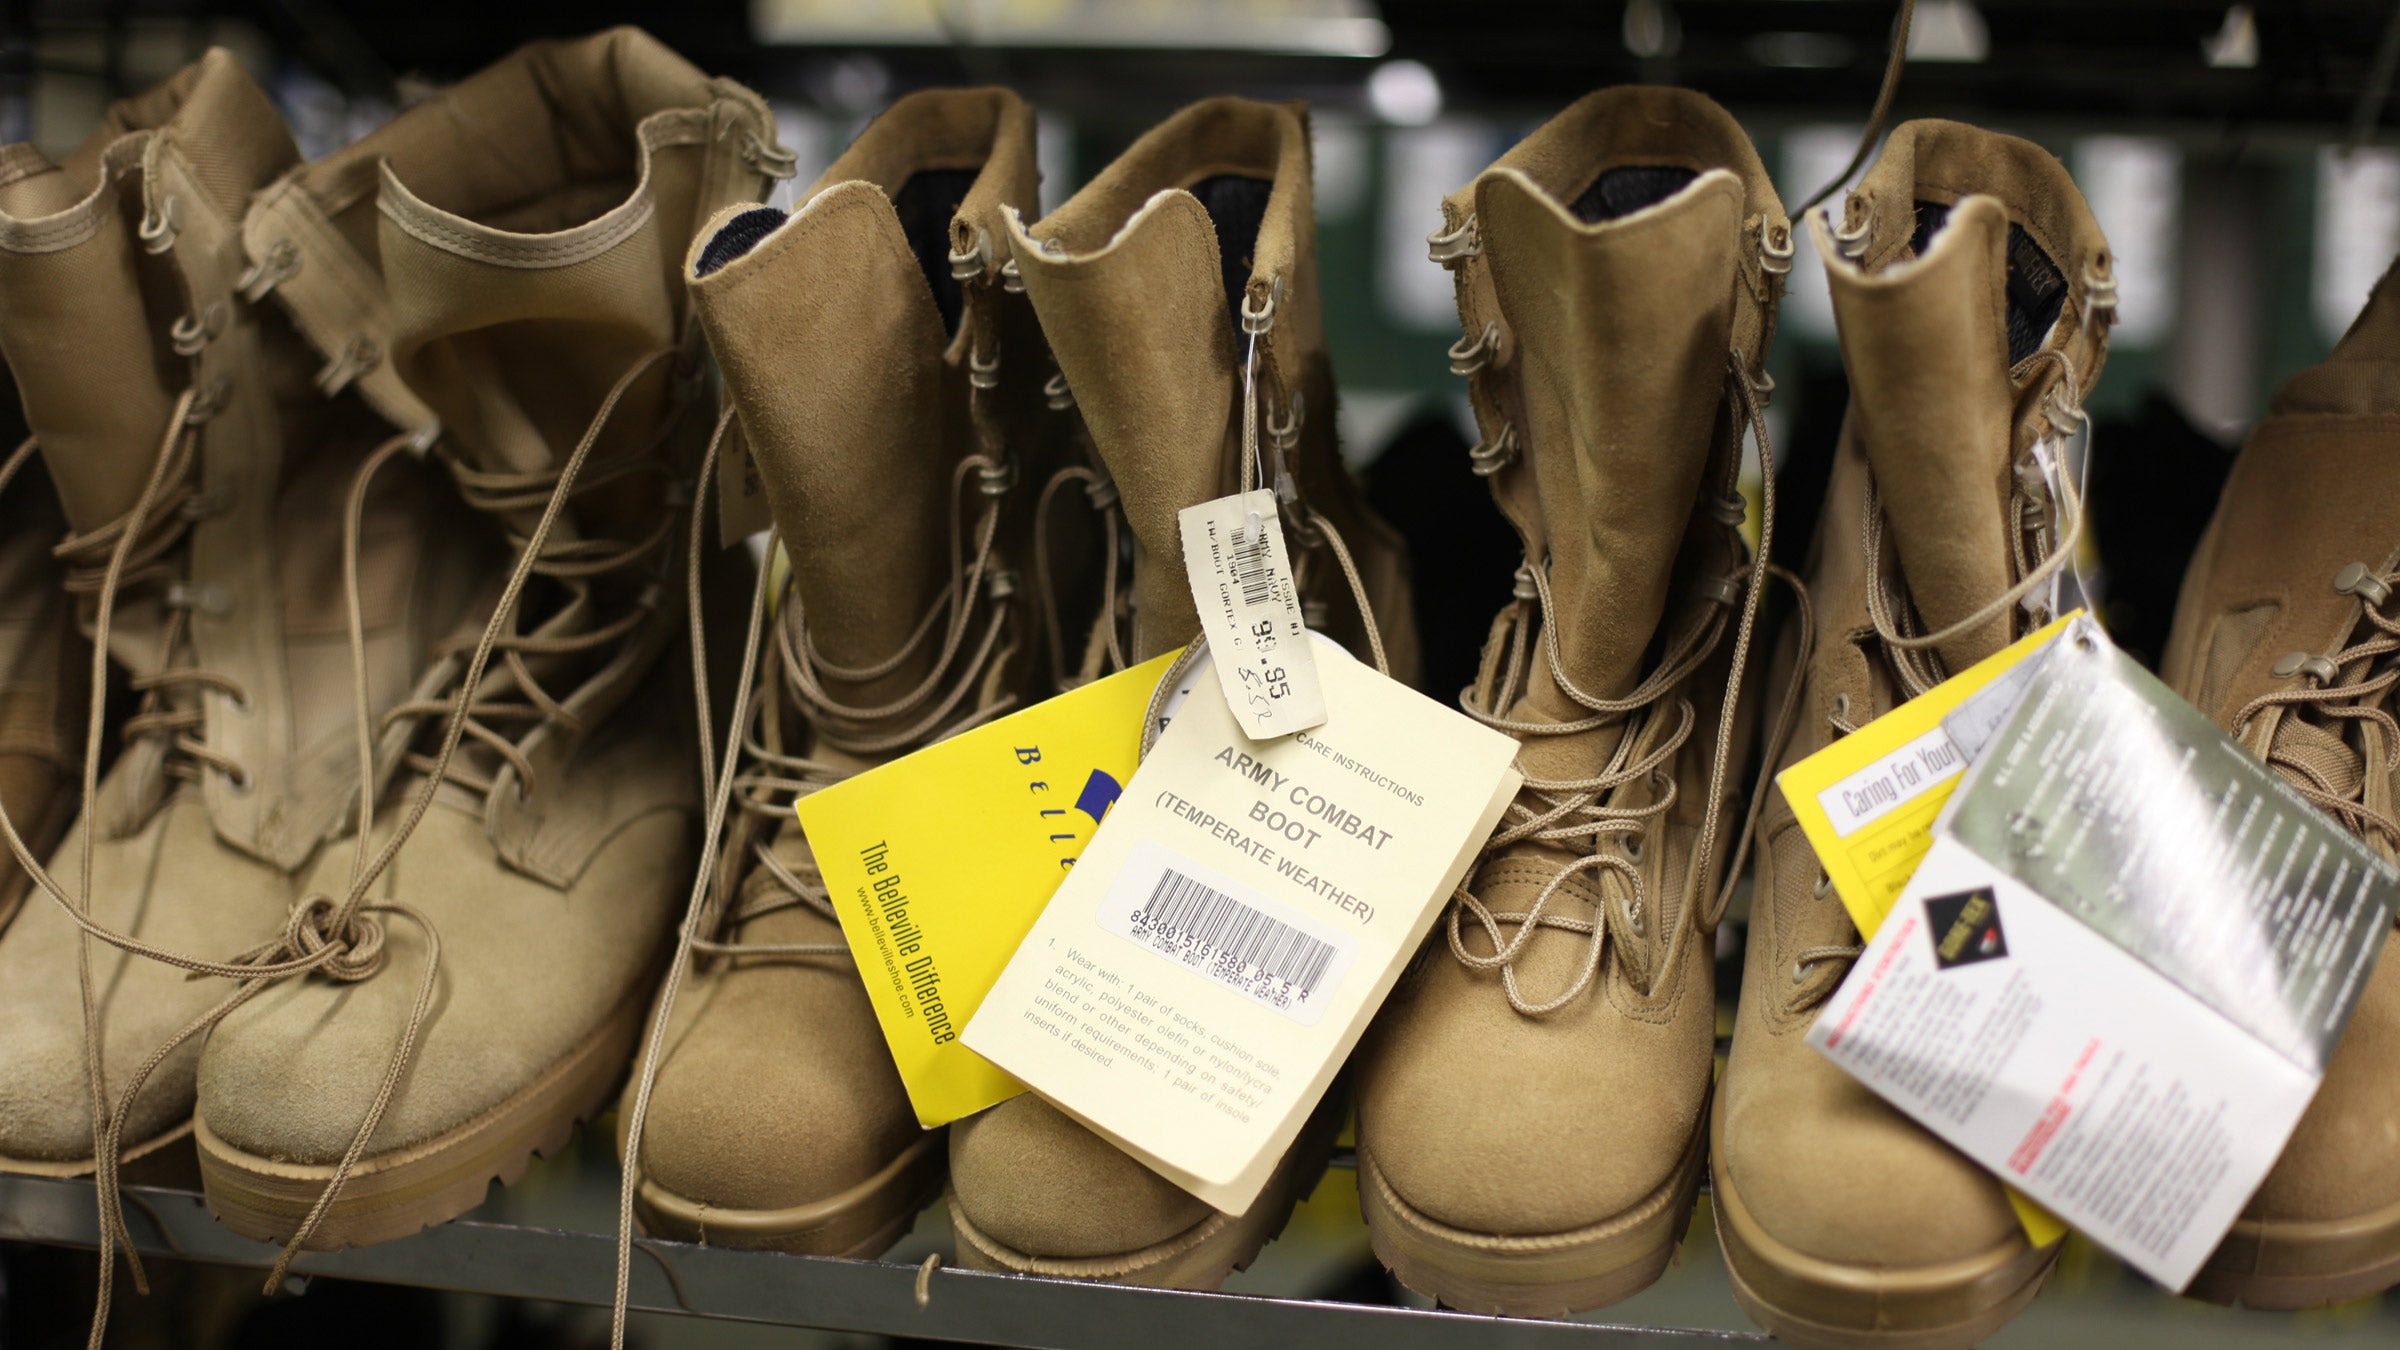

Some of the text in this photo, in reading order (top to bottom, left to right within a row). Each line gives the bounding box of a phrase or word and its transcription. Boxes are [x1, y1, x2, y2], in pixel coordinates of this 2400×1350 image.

[1225, 553, 1240, 585] 1904
[1252, 522, 1272, 561] RMY
[1218, 582, 1237, 630] GORTEX
[1278, 576, 1296, 615] ISSUE
[1214, 746, 1393, 850] ARMY COMBAT
[1294, 731, 1424, 807] CARE INSTRUCTIONS
[1840, 739, 1958, 819] Caring For Your
[1155, 790, 1374, 925] (TEMPERATE WEATHER)
[1248, 800, 1322, 849] BOOT
[856, 886, 915, 1018] www.bellevilleshoe.com
[860, 840, 956, 1045] The Belleville Difference
[1129, 923, 1152, 943] ARMY
[1151, 935, 1182, 958] COMBAT
[1182, 949, 1204, 968] BOOT
[1204, 960, 1253, 992] (TEMPERATE
[1043, 978, 1079, 1005] blend
[1080, 1001, 1096, 1015] or
[1097, 1009, 1132, 1036] other
[1132, 1030, 1198, 1076] depending
[1199, 1069, 1217, 1085] on
[1045, 936, 1059, 951] 1.
[1064, 947, 1099, 974] Wear
[1096, 965, 1125, 988] with:
[1125, 983, 1134, 994] 1
[1133, 988, 1159, 1009] pair
[1158, 1002, 1173, 1017] of
[1172, 1010, 1210, 1040] socks,
[1208, 1030, 1255, 1064] cushion
[1053, 963, 1273, 1096] acrylic, polyester olefin or nylon/lycra
[1297, 988, 1310, 1003] R
[1022, 1007, 1117, 1070] inserts if desired.
[1032, 993, 1078, 1026] uniform
[1171, 1074, 1198, 1096] pair
[1198, 1089, 1214, 1104] of
[1214, 1097, 1252, 1124] insole
